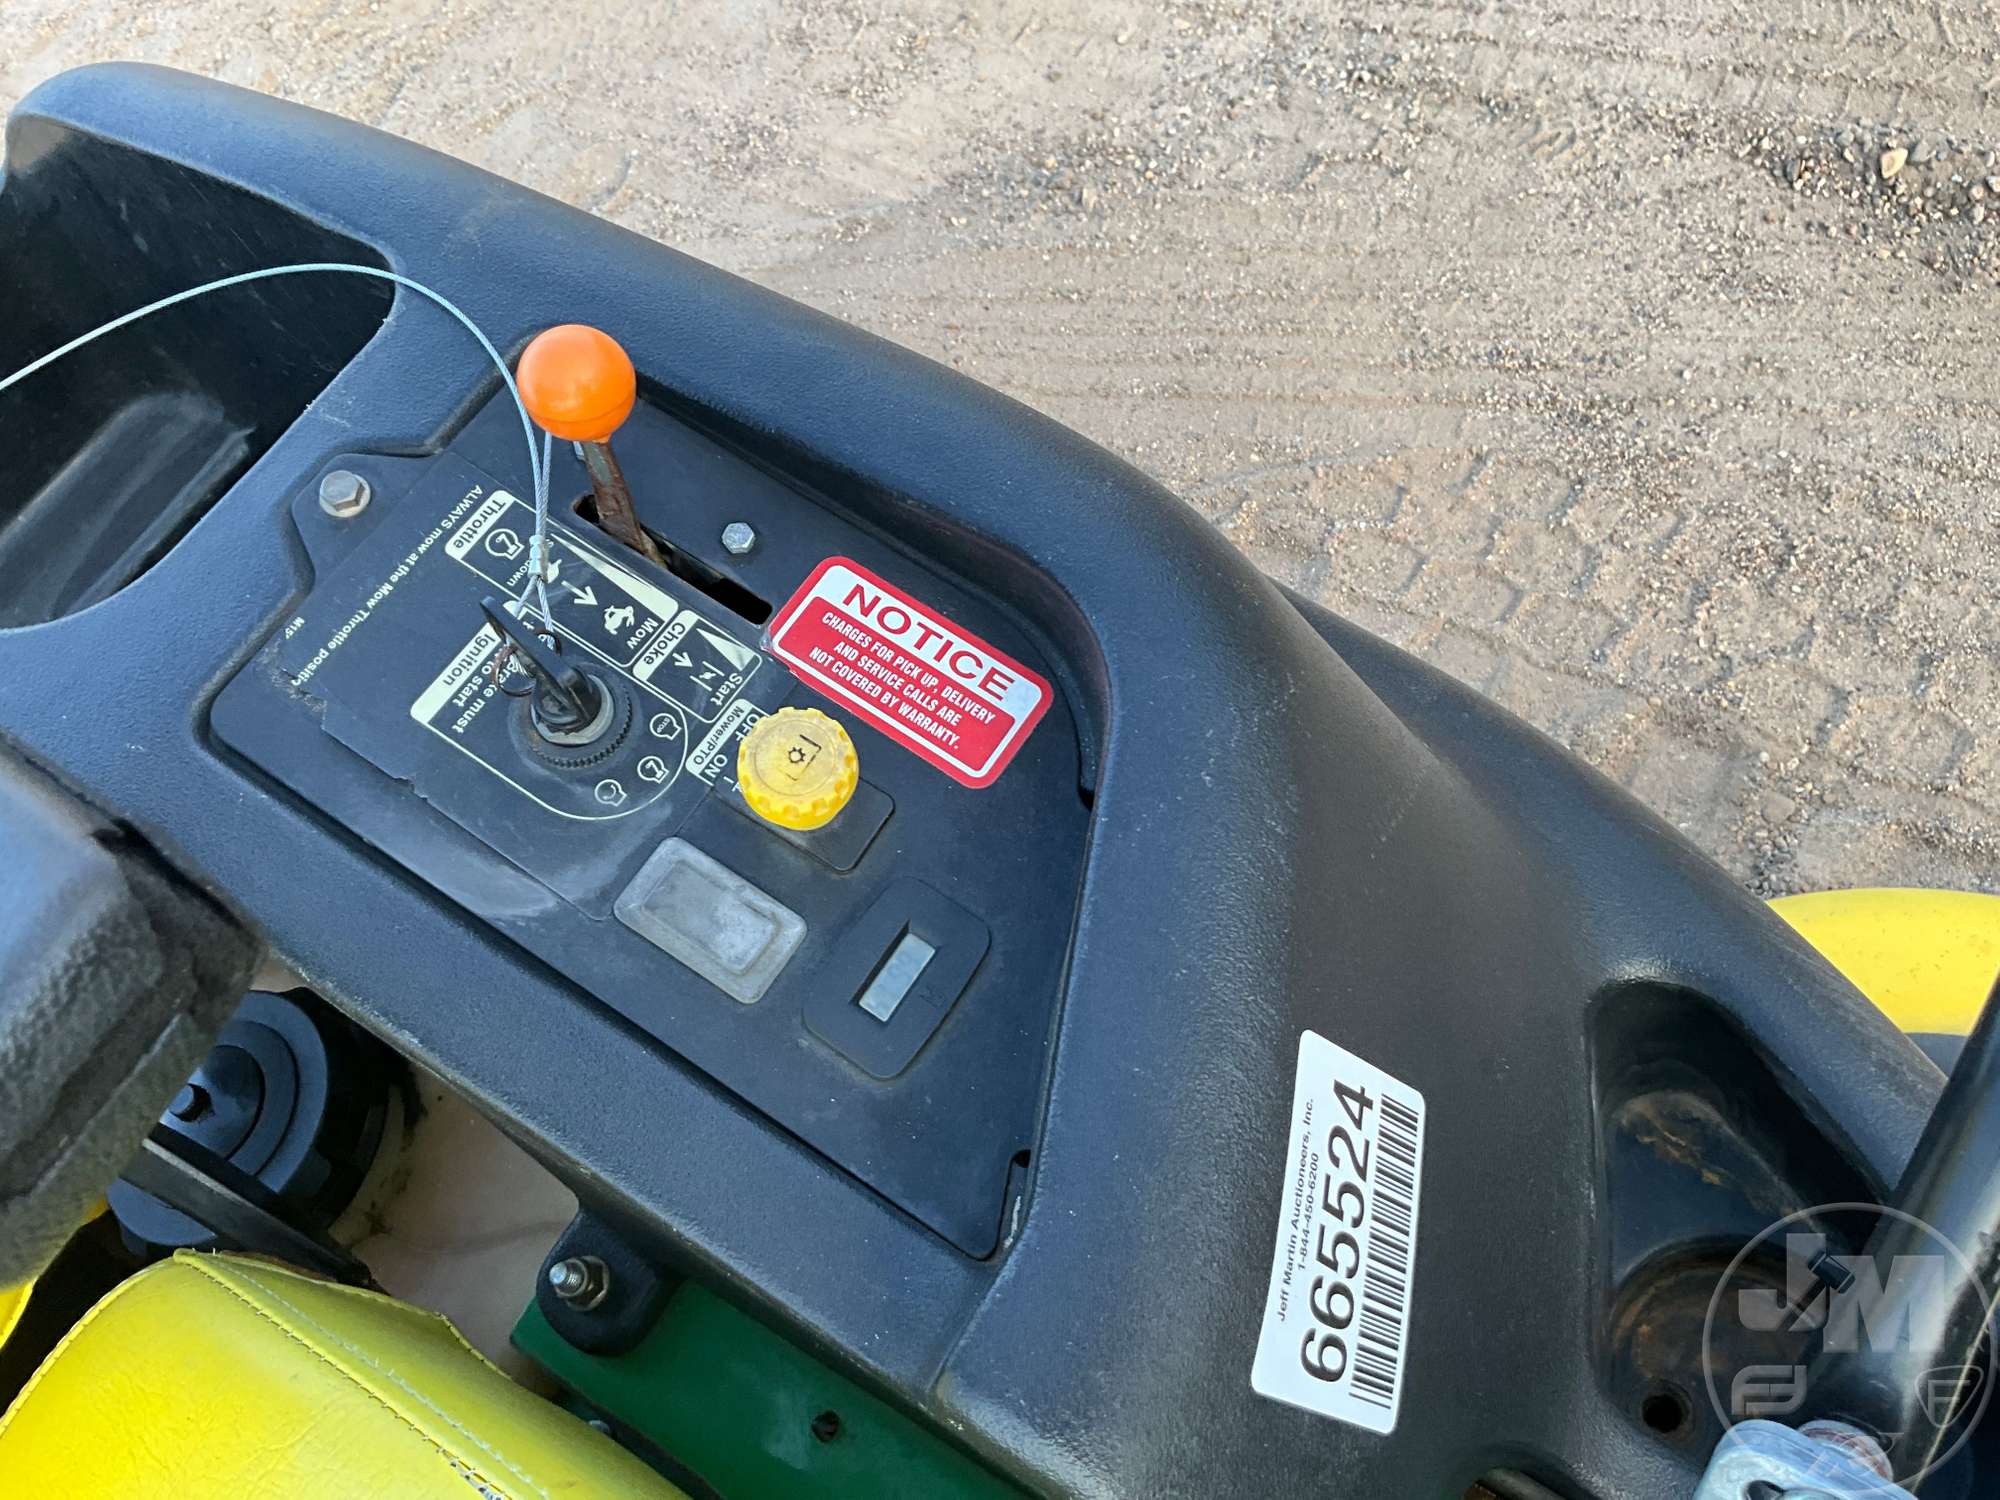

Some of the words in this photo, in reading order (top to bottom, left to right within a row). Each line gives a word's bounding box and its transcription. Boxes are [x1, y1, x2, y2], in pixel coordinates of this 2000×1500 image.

[441, 485, 484, 529] ALWAYS
[453, 499, 506, 549] Throttle
[405, 552, 419, 566] at
[417, 528, 443, 554] mow
[389, 564, 410, 582] the
[366, 582, 394, 609] Mow
[328, 609, 370, 649] Throttle
[626, 617, 659, 649] Mow
[643, 622, 686, 665] Choke
[842, 583, 1015, 702] NOTICE
[443, 633, 496, 686] Ignition
[822, 612, 873, 648] CHARGES
[870, 641, 895, 662] FOR
[893, 656, 922, 679] PICK
[920, 673, 938, 693] UP,
[941, 686, 996, 724] DELIVERY
[452, 675, 483, 707] start
[710, 672, 743, 706] Start
[809, 646, 834, 667] NOT
[831, 661, 883, 699] COVERED
[881, 692, 899, 708] BY
[898, 702, 960, 749] WARRANTY.
[833, 641, 859, 661] AND
[857, 655, 904, 690] SERVICE
[903, 684, 938, 711] CALLS
[936, 706, 962, 726] ARE
[452, 698, 486, 734] must
[656, 717, 671, 734] STOP
[693, 706, 744, 766] Mower/PTO
[704, 754, 728, 778] ON
[1277, 1289, 1289, 1322] Jeff
[1283, 1234, 1297, 1285] Martin
[1291, 1131, 1311, 1230] Auctioneers,
[1302, 1098, 1313, 1126] Inc.
[1298, 1152, 1319, 1270] 1-844-450-6200
[1300, 1078, 1374, 1383] 665524
